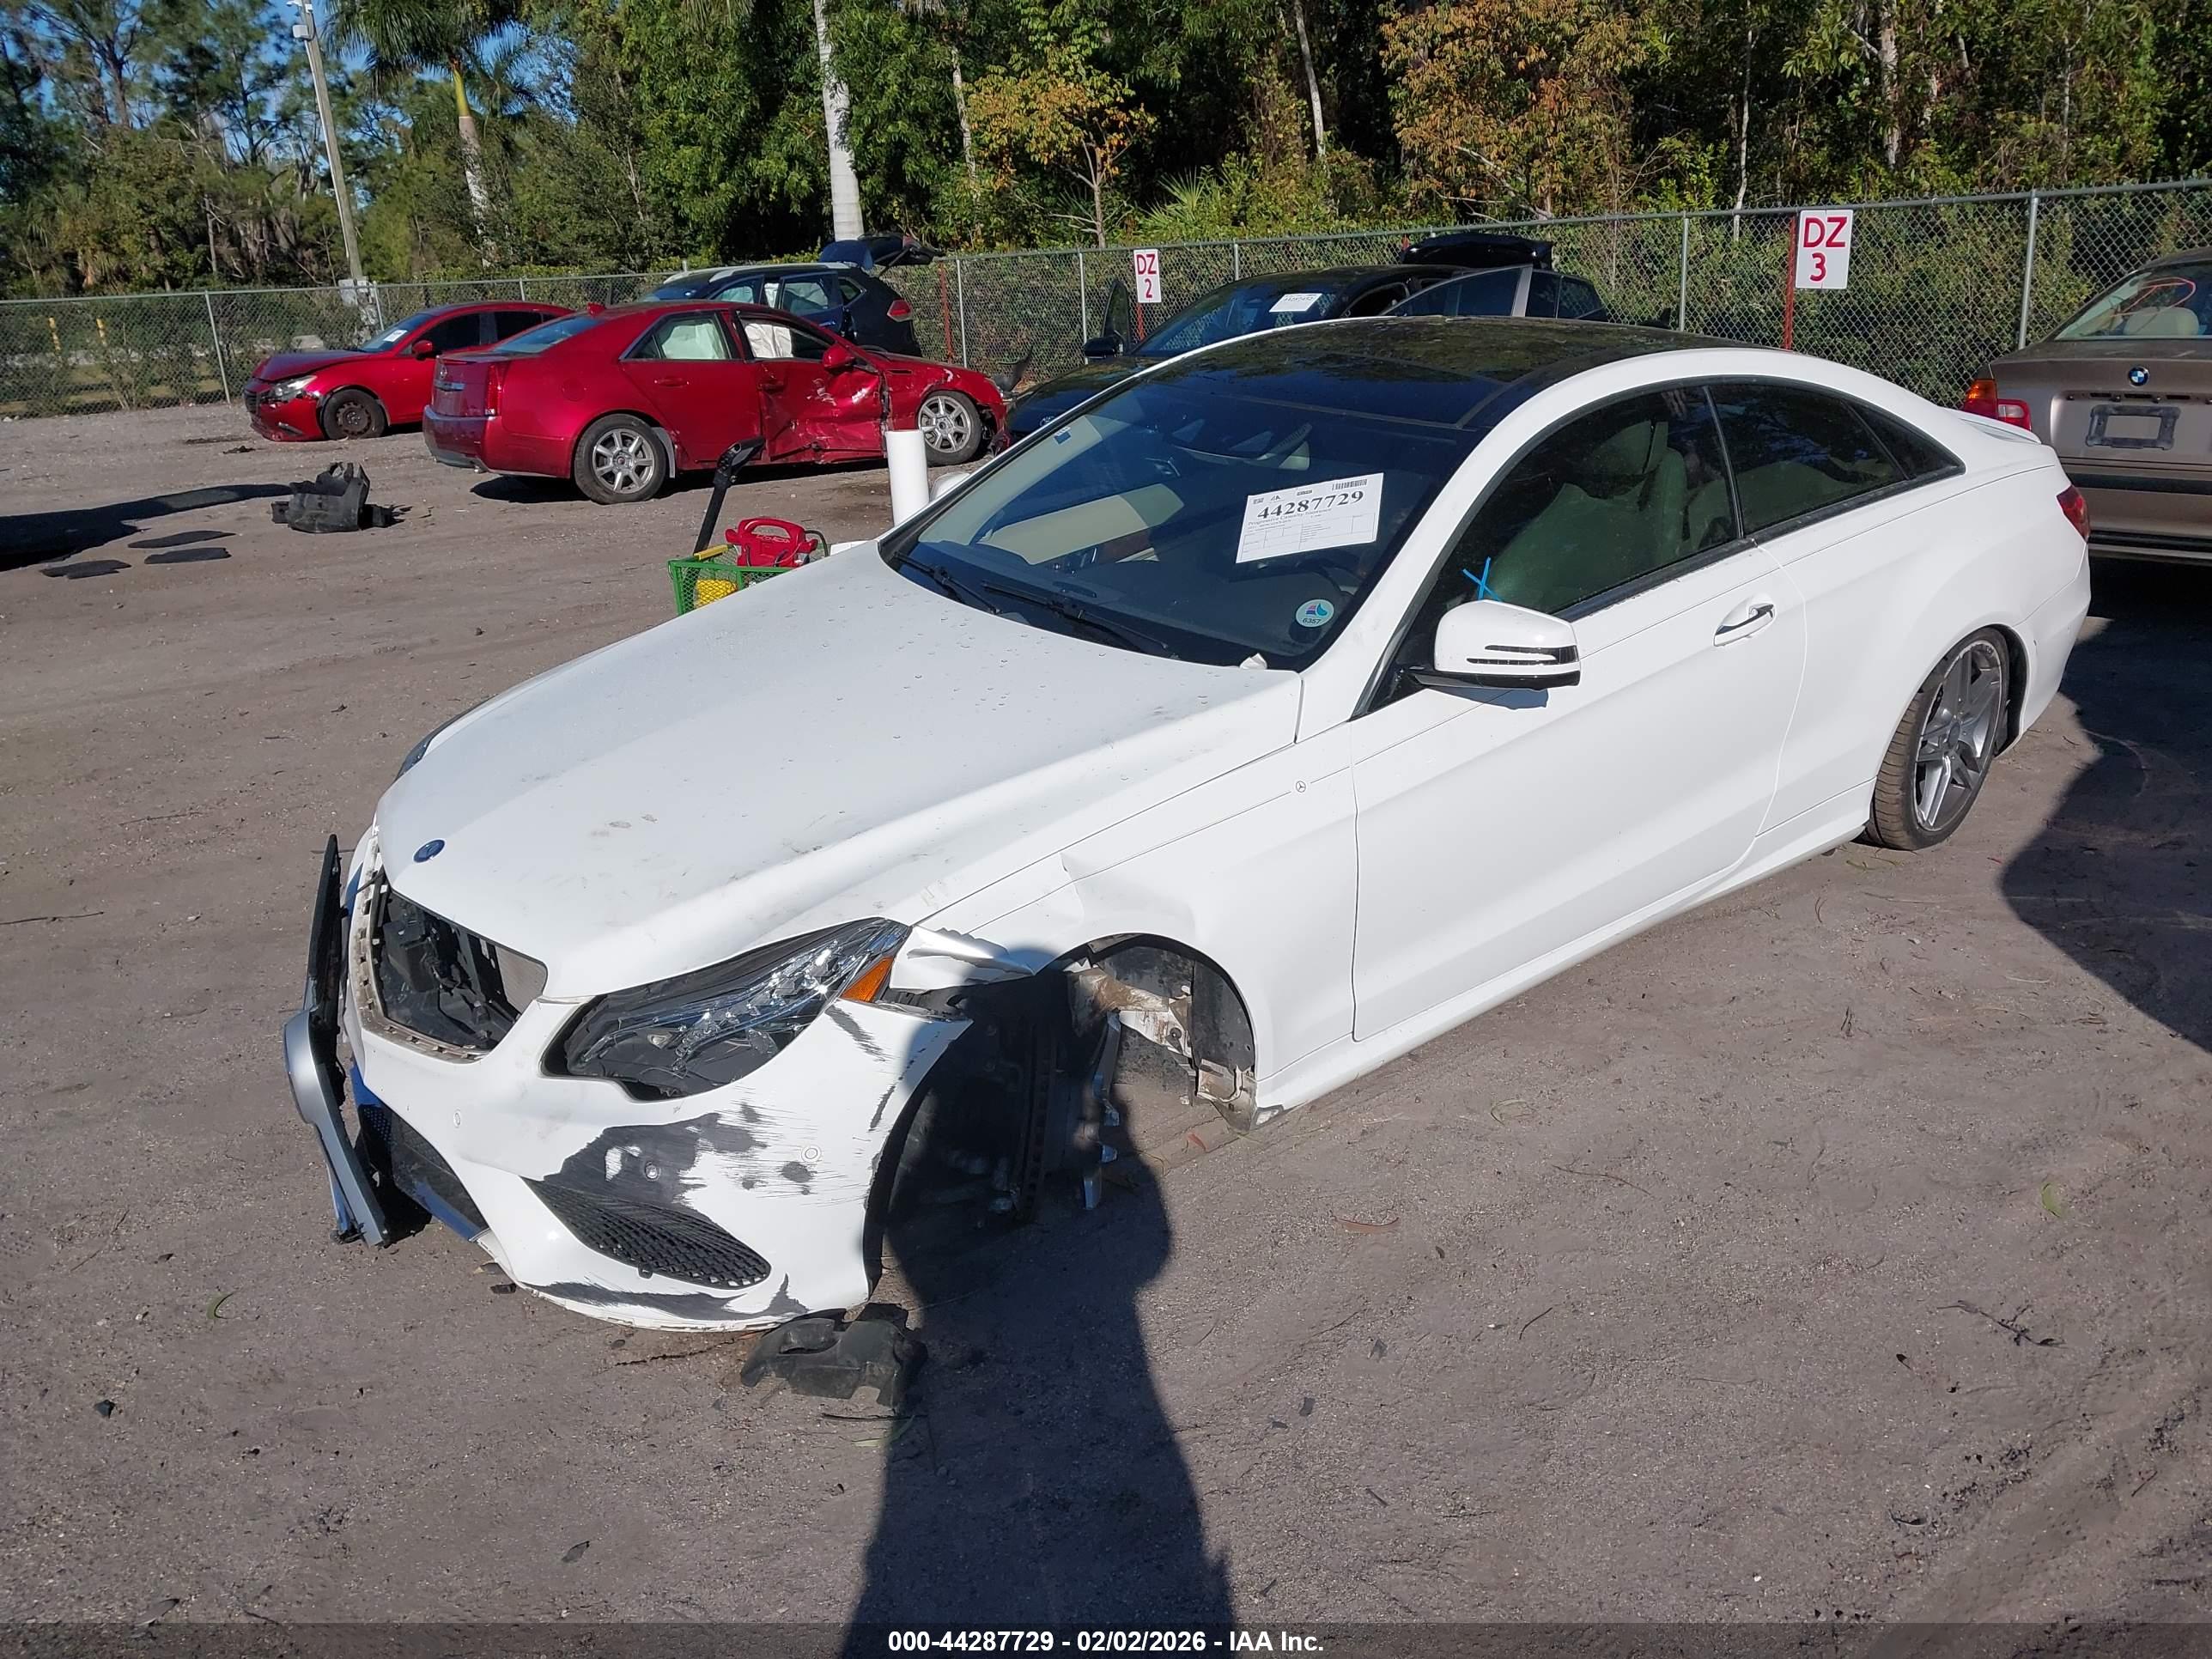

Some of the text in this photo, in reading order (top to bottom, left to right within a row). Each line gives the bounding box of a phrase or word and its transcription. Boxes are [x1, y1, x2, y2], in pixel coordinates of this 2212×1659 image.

[1803, 216, 1848, 248] DZ
[1136, 253, 1157, 275] DZ
[1809, 252, 1826, 282] 3
[1144, 277, 1152, 298] 2
[1257, 490, 1364, 520] 44287729
